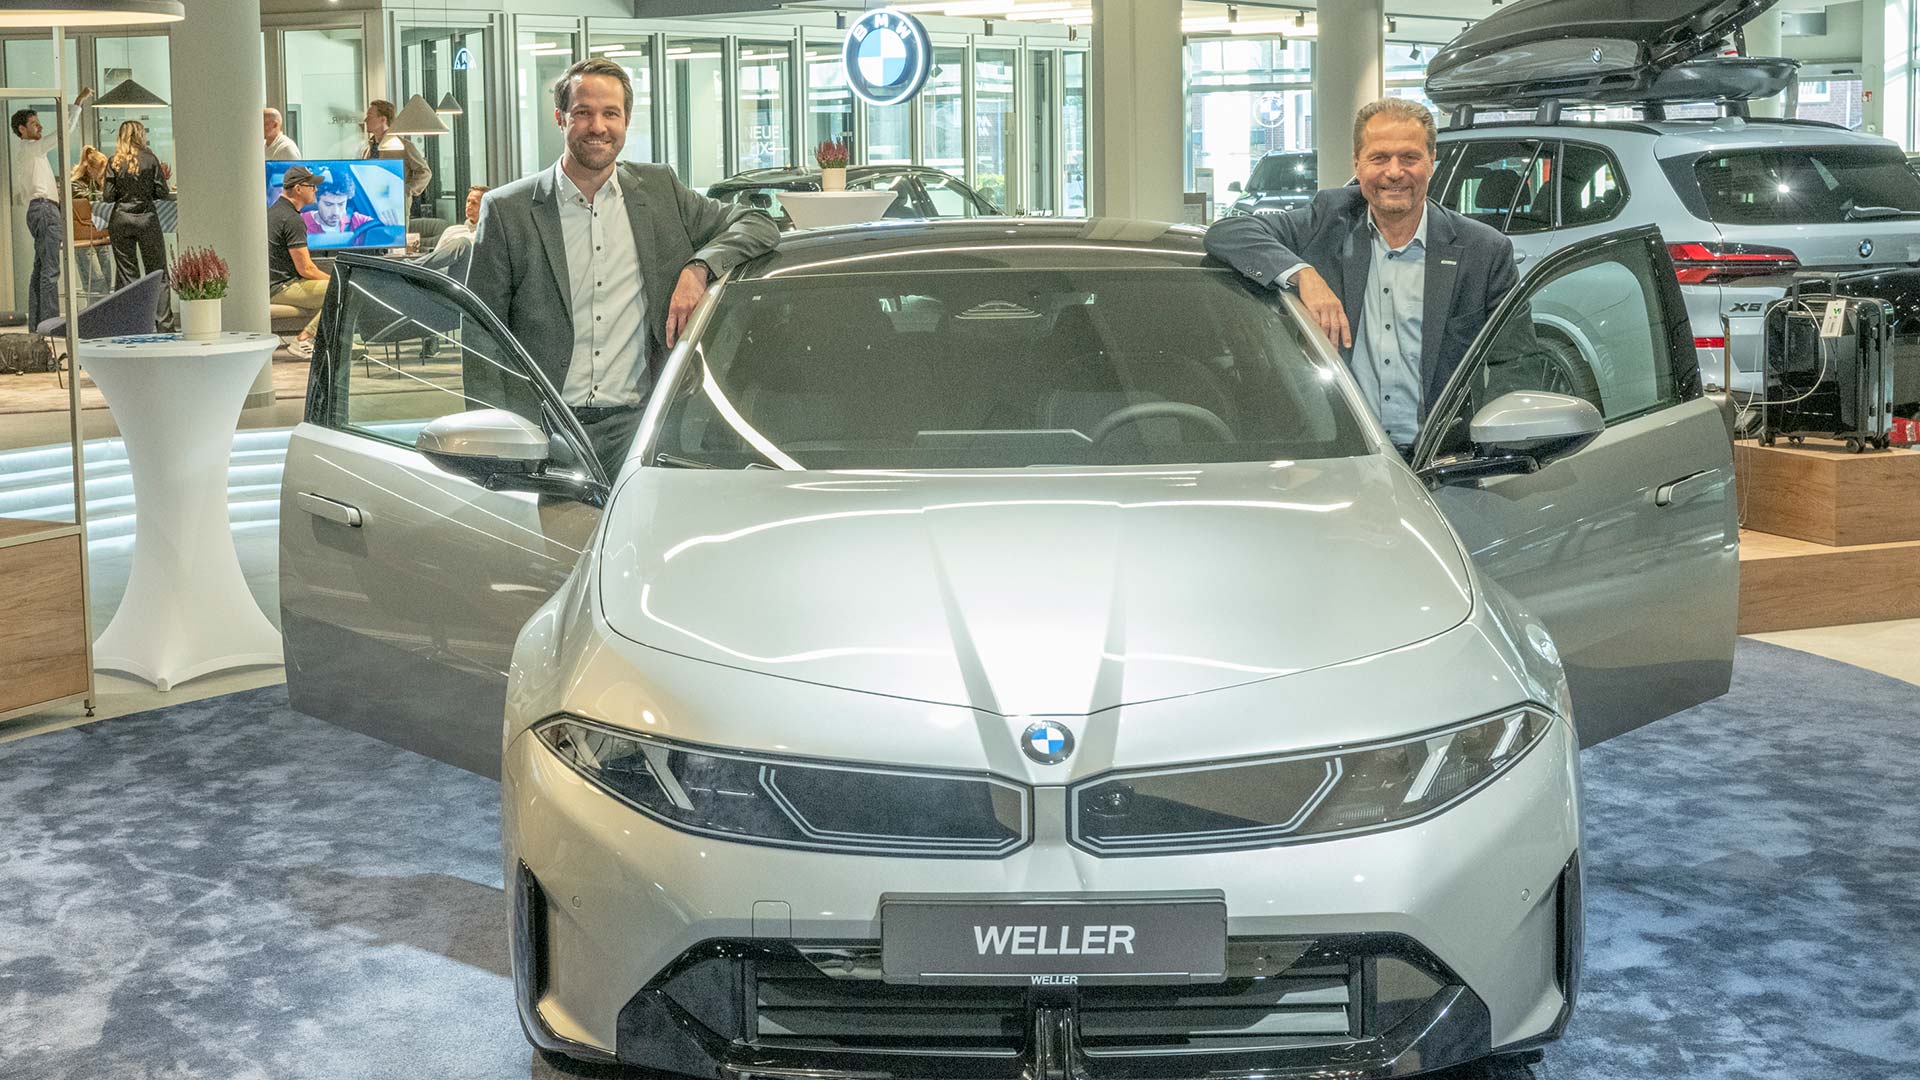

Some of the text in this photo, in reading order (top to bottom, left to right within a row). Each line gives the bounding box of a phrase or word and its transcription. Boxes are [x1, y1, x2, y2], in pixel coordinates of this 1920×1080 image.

[853, 14, 911, 42] BMW
[744, 126, 780, 139] NEUE
[973, 925, 1136, 955] WELLER
[1031, 976, 1079, 985] WELLER
